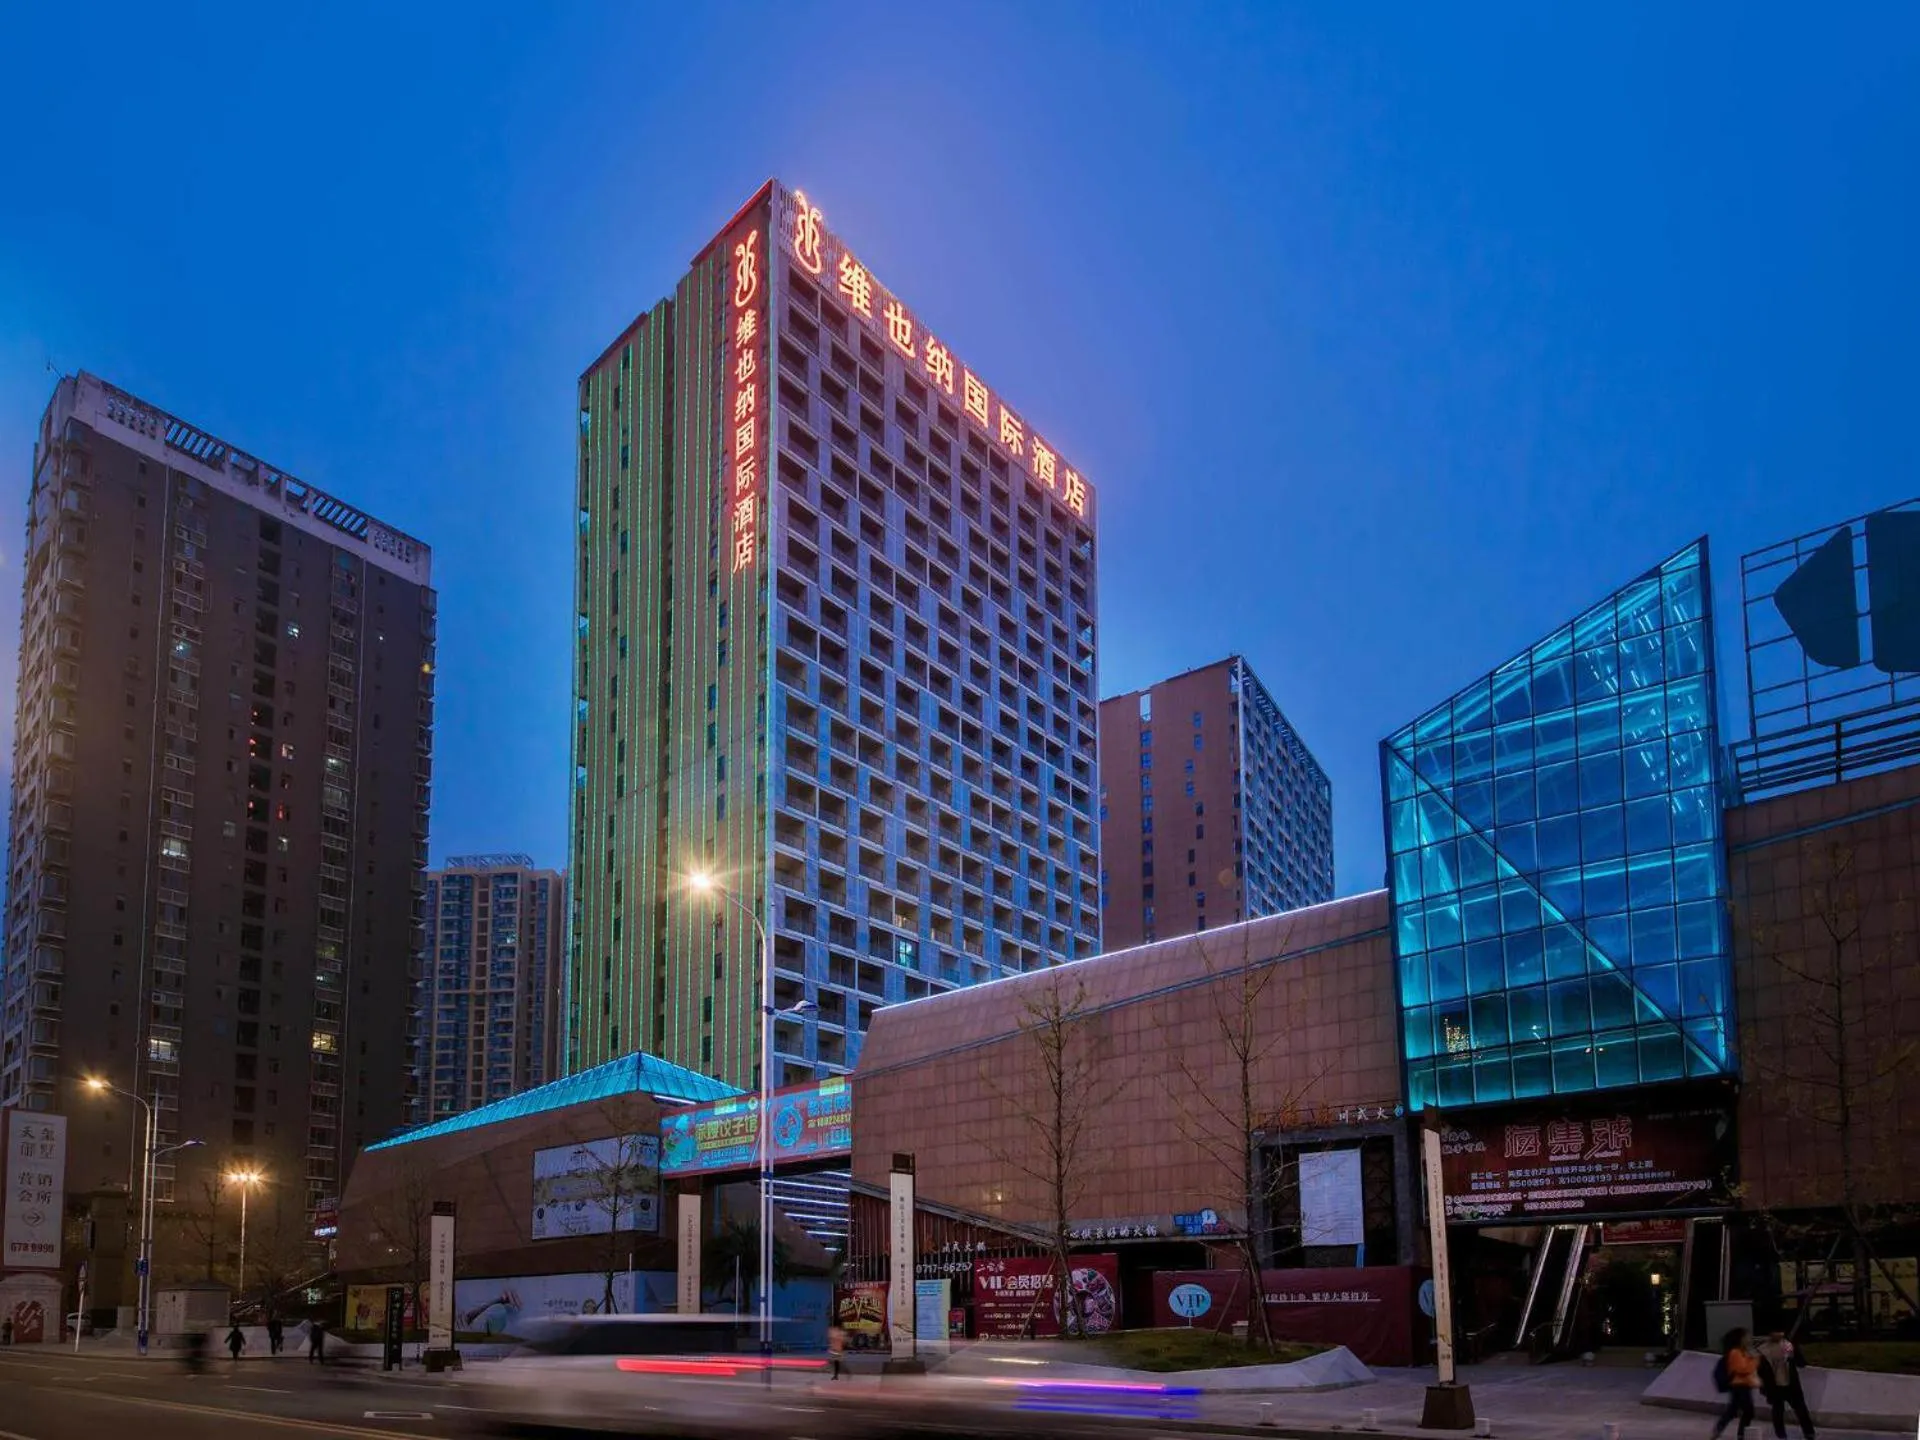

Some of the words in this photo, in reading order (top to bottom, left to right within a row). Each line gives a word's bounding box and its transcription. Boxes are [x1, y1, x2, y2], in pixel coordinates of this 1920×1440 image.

[733, 308, 757, 575] 维也纳国际酒店
[839, 254, 1086, 518] 维也纳国际酒店
[1176, 1292, 1206, 1308] VIP
